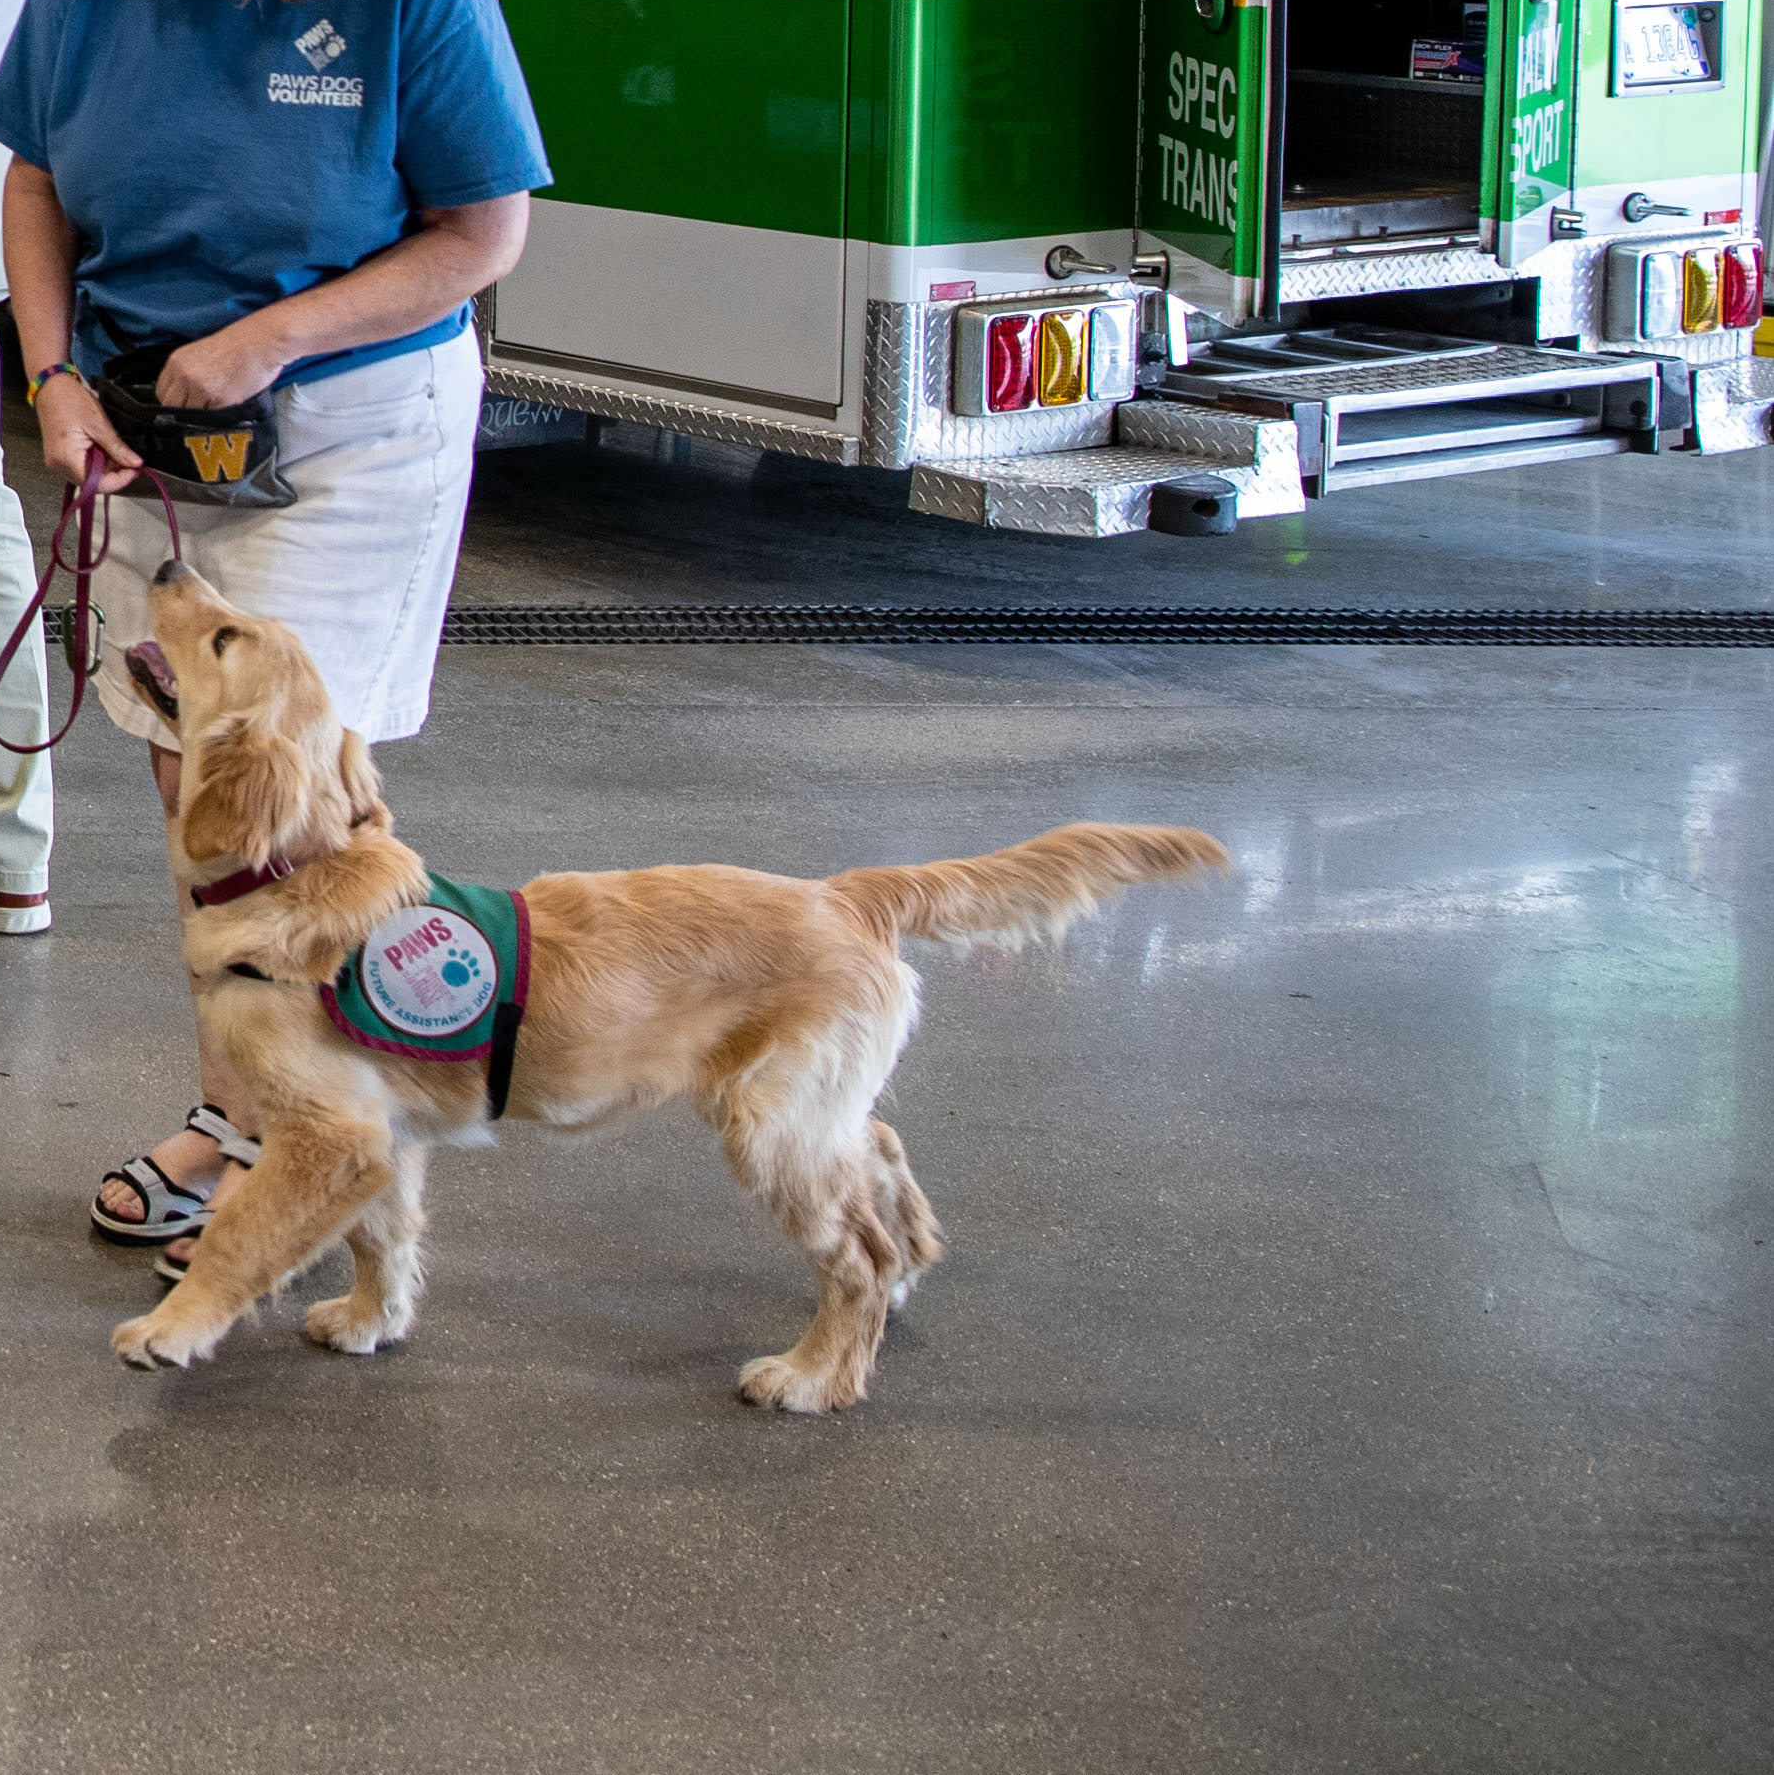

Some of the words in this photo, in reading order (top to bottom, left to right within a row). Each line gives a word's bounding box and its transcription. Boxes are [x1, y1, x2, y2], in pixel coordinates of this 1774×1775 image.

[267, 87, 363, 106] VOLUNTEER
[269, 73, 319, 91] PAWS
[321, 75, 363, 93] DOG
[1168, 51, 1236, 139] SPEC
[184, 430, 253, 482] W
[383, 915, 453, 972] PAWS
